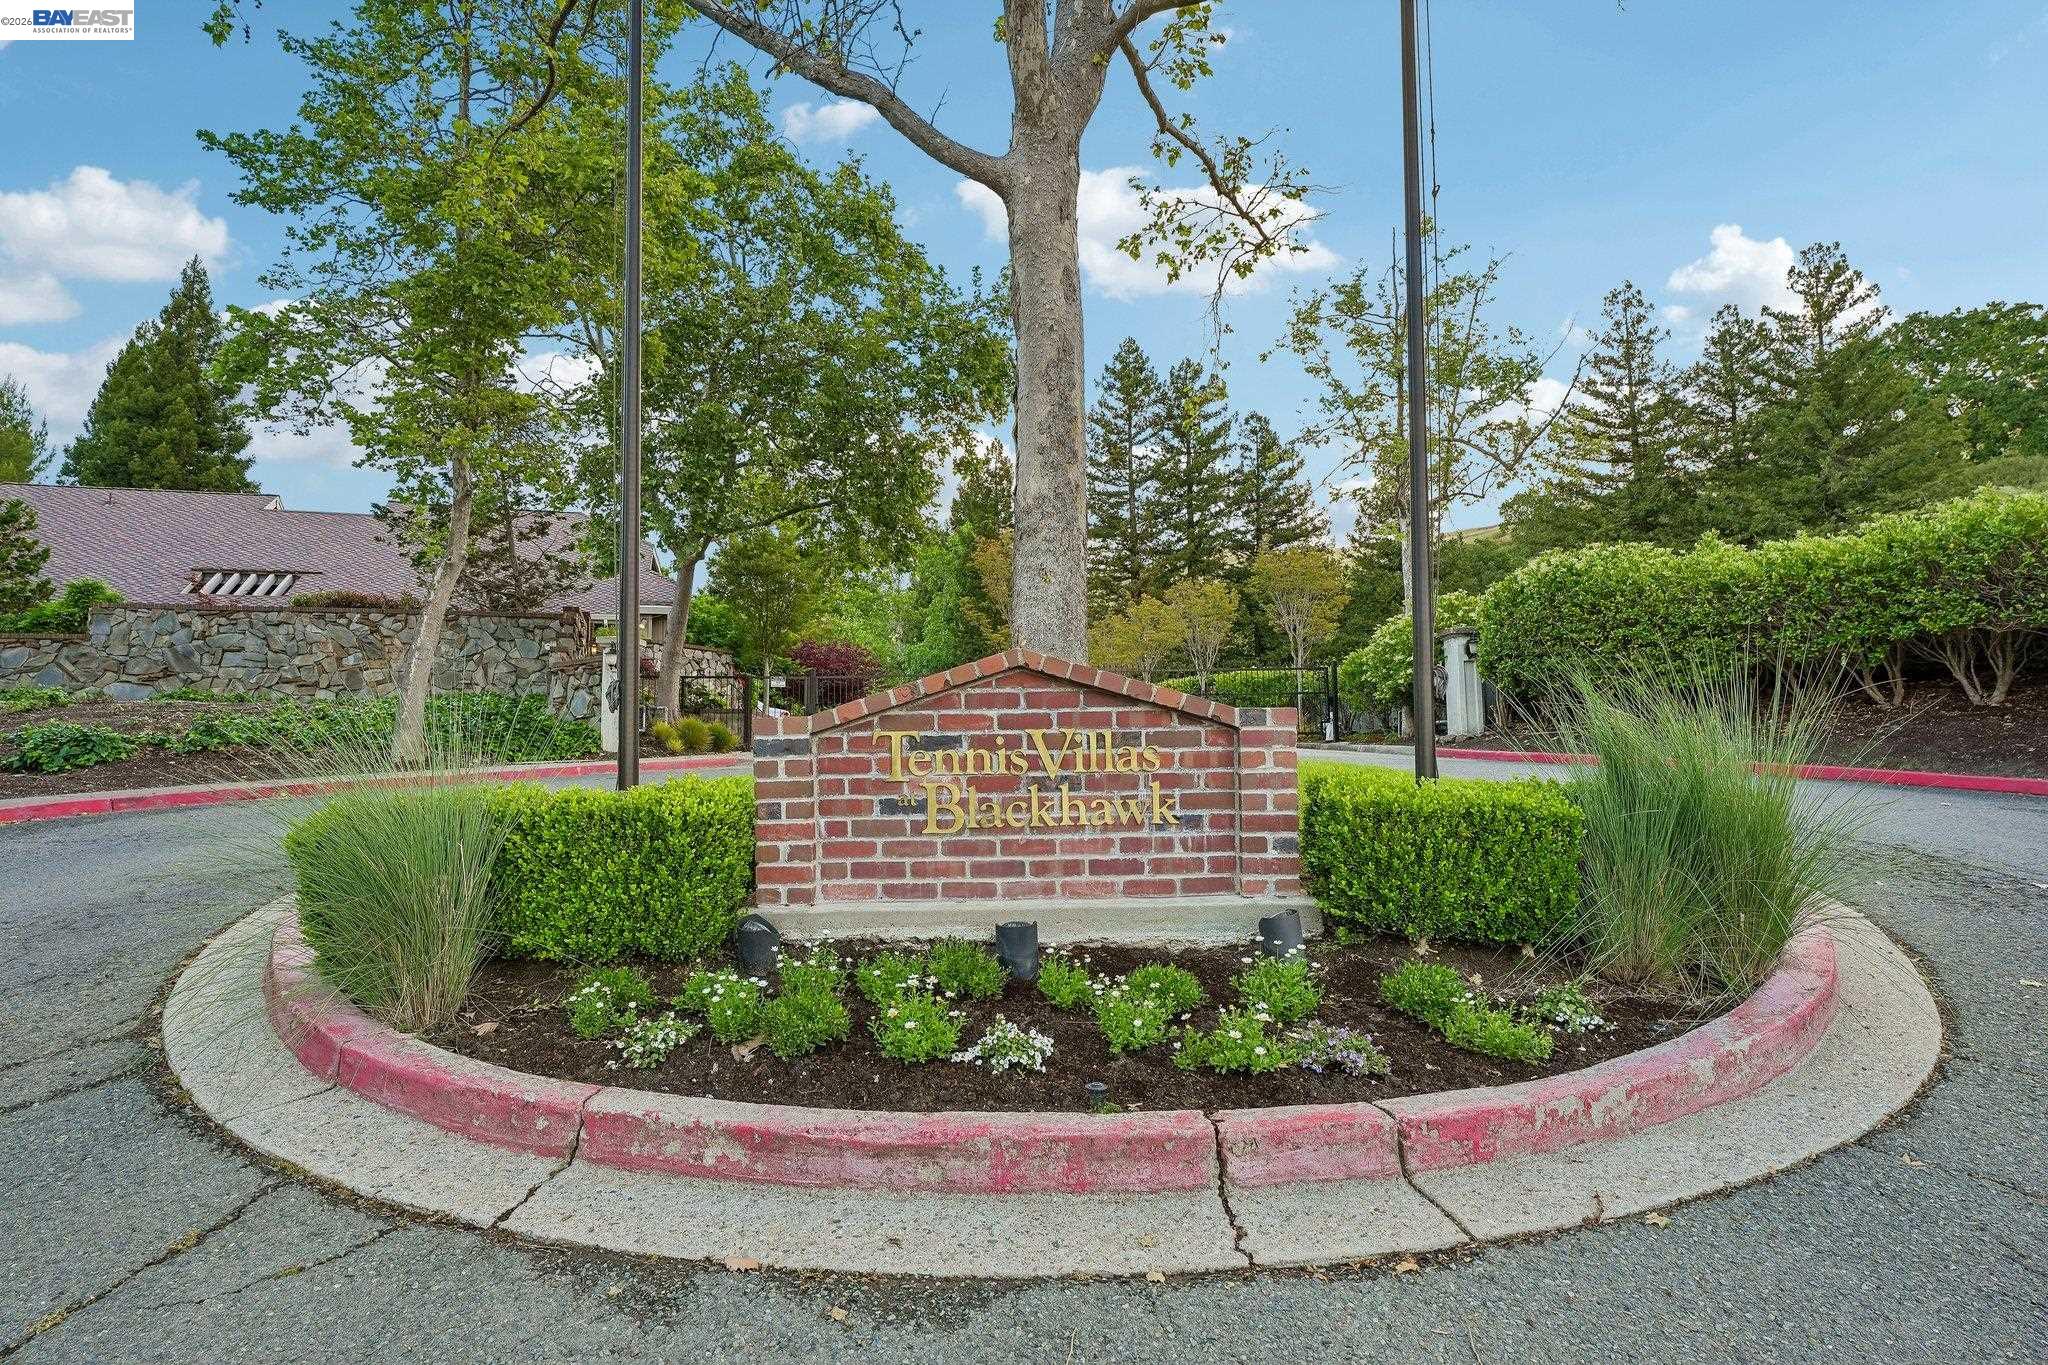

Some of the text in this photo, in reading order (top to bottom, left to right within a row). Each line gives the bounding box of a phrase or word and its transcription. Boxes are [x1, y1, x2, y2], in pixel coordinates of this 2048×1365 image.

[872, 728, 1161, 782] Tennis Villas
[919, 781, 1180, 834] Blackhawk
